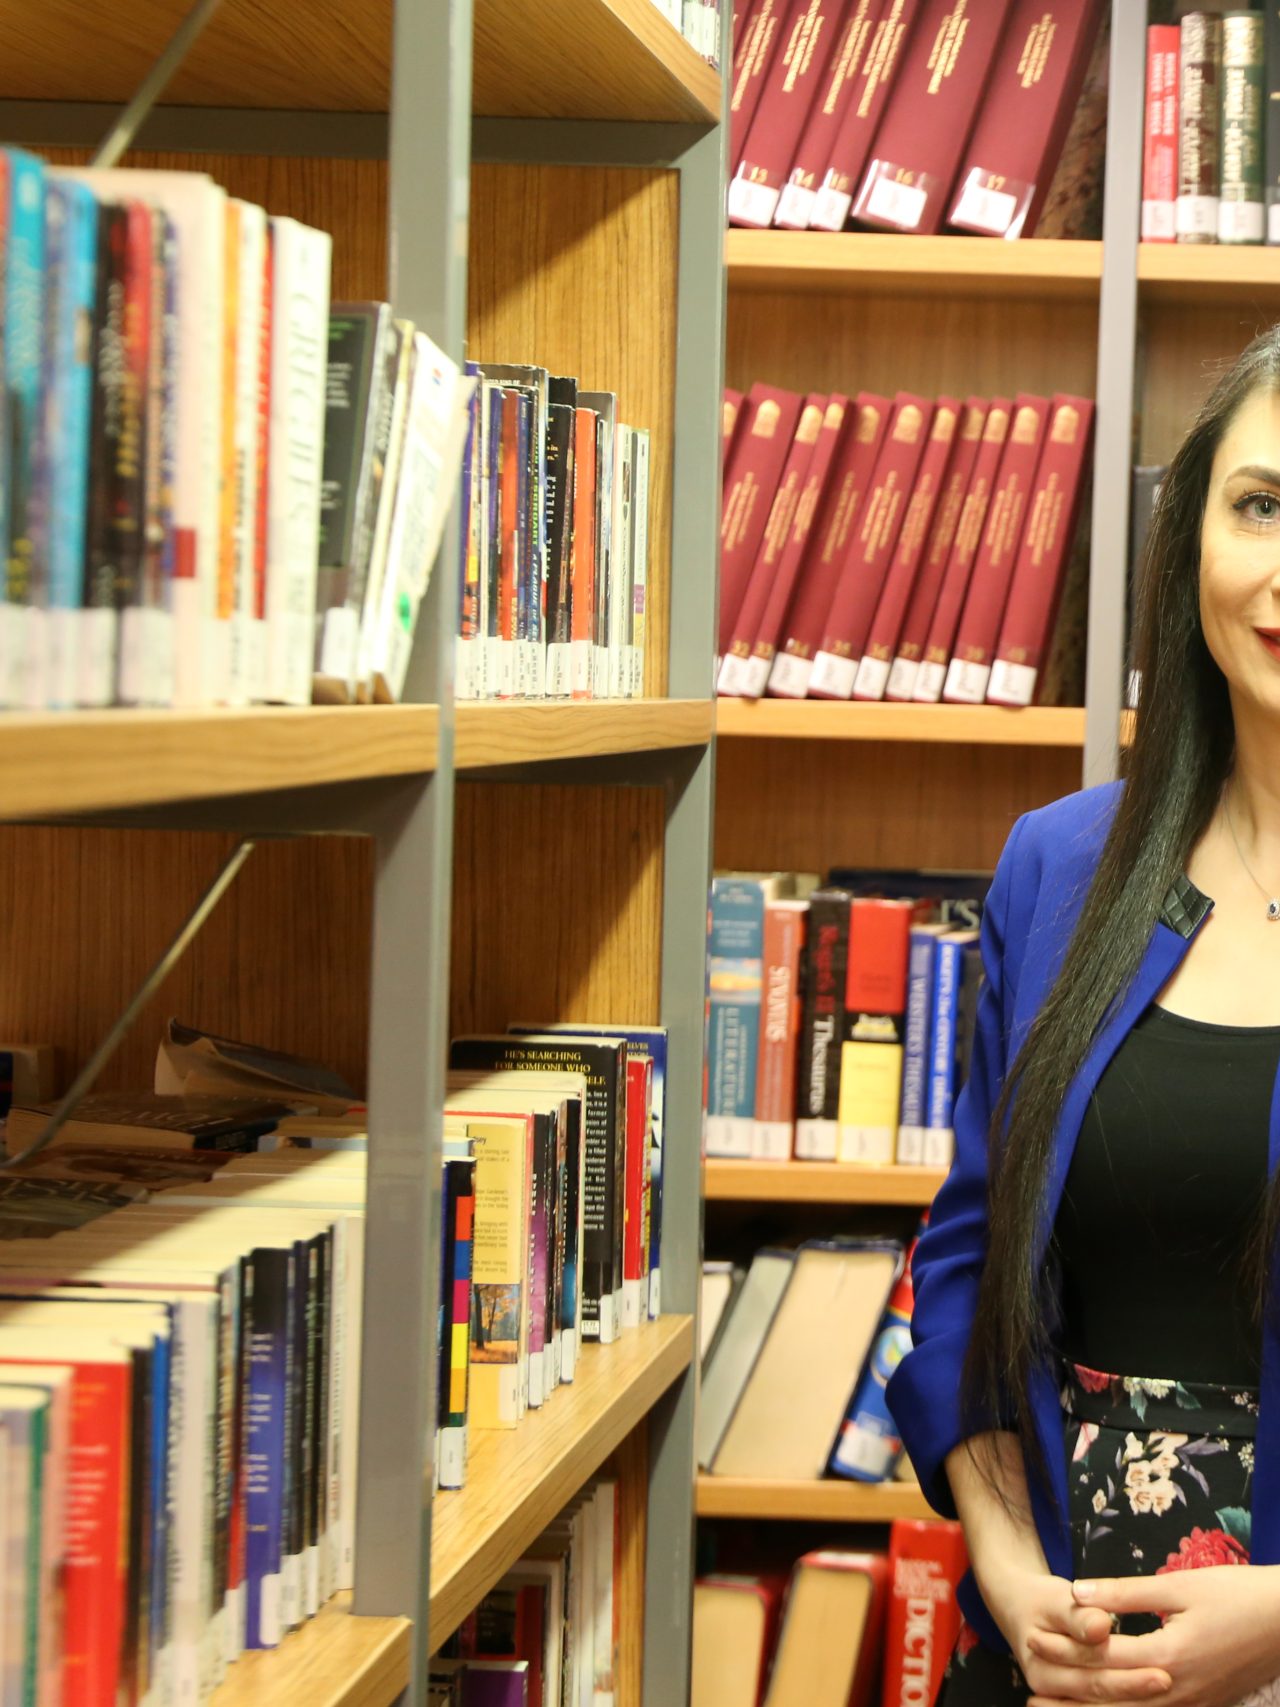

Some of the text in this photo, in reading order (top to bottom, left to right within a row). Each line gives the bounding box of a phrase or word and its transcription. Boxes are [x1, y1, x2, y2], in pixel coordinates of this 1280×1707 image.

[516, 1062, 564, 1071] SOMEONE
[566, 1063, 591, 1073] WHO
[527, 1050, 582, 1060] SEARCHING
[809, 1015, 835, 1114] Thesaurus
[901, 1598, 935, 1707] DICTIO
